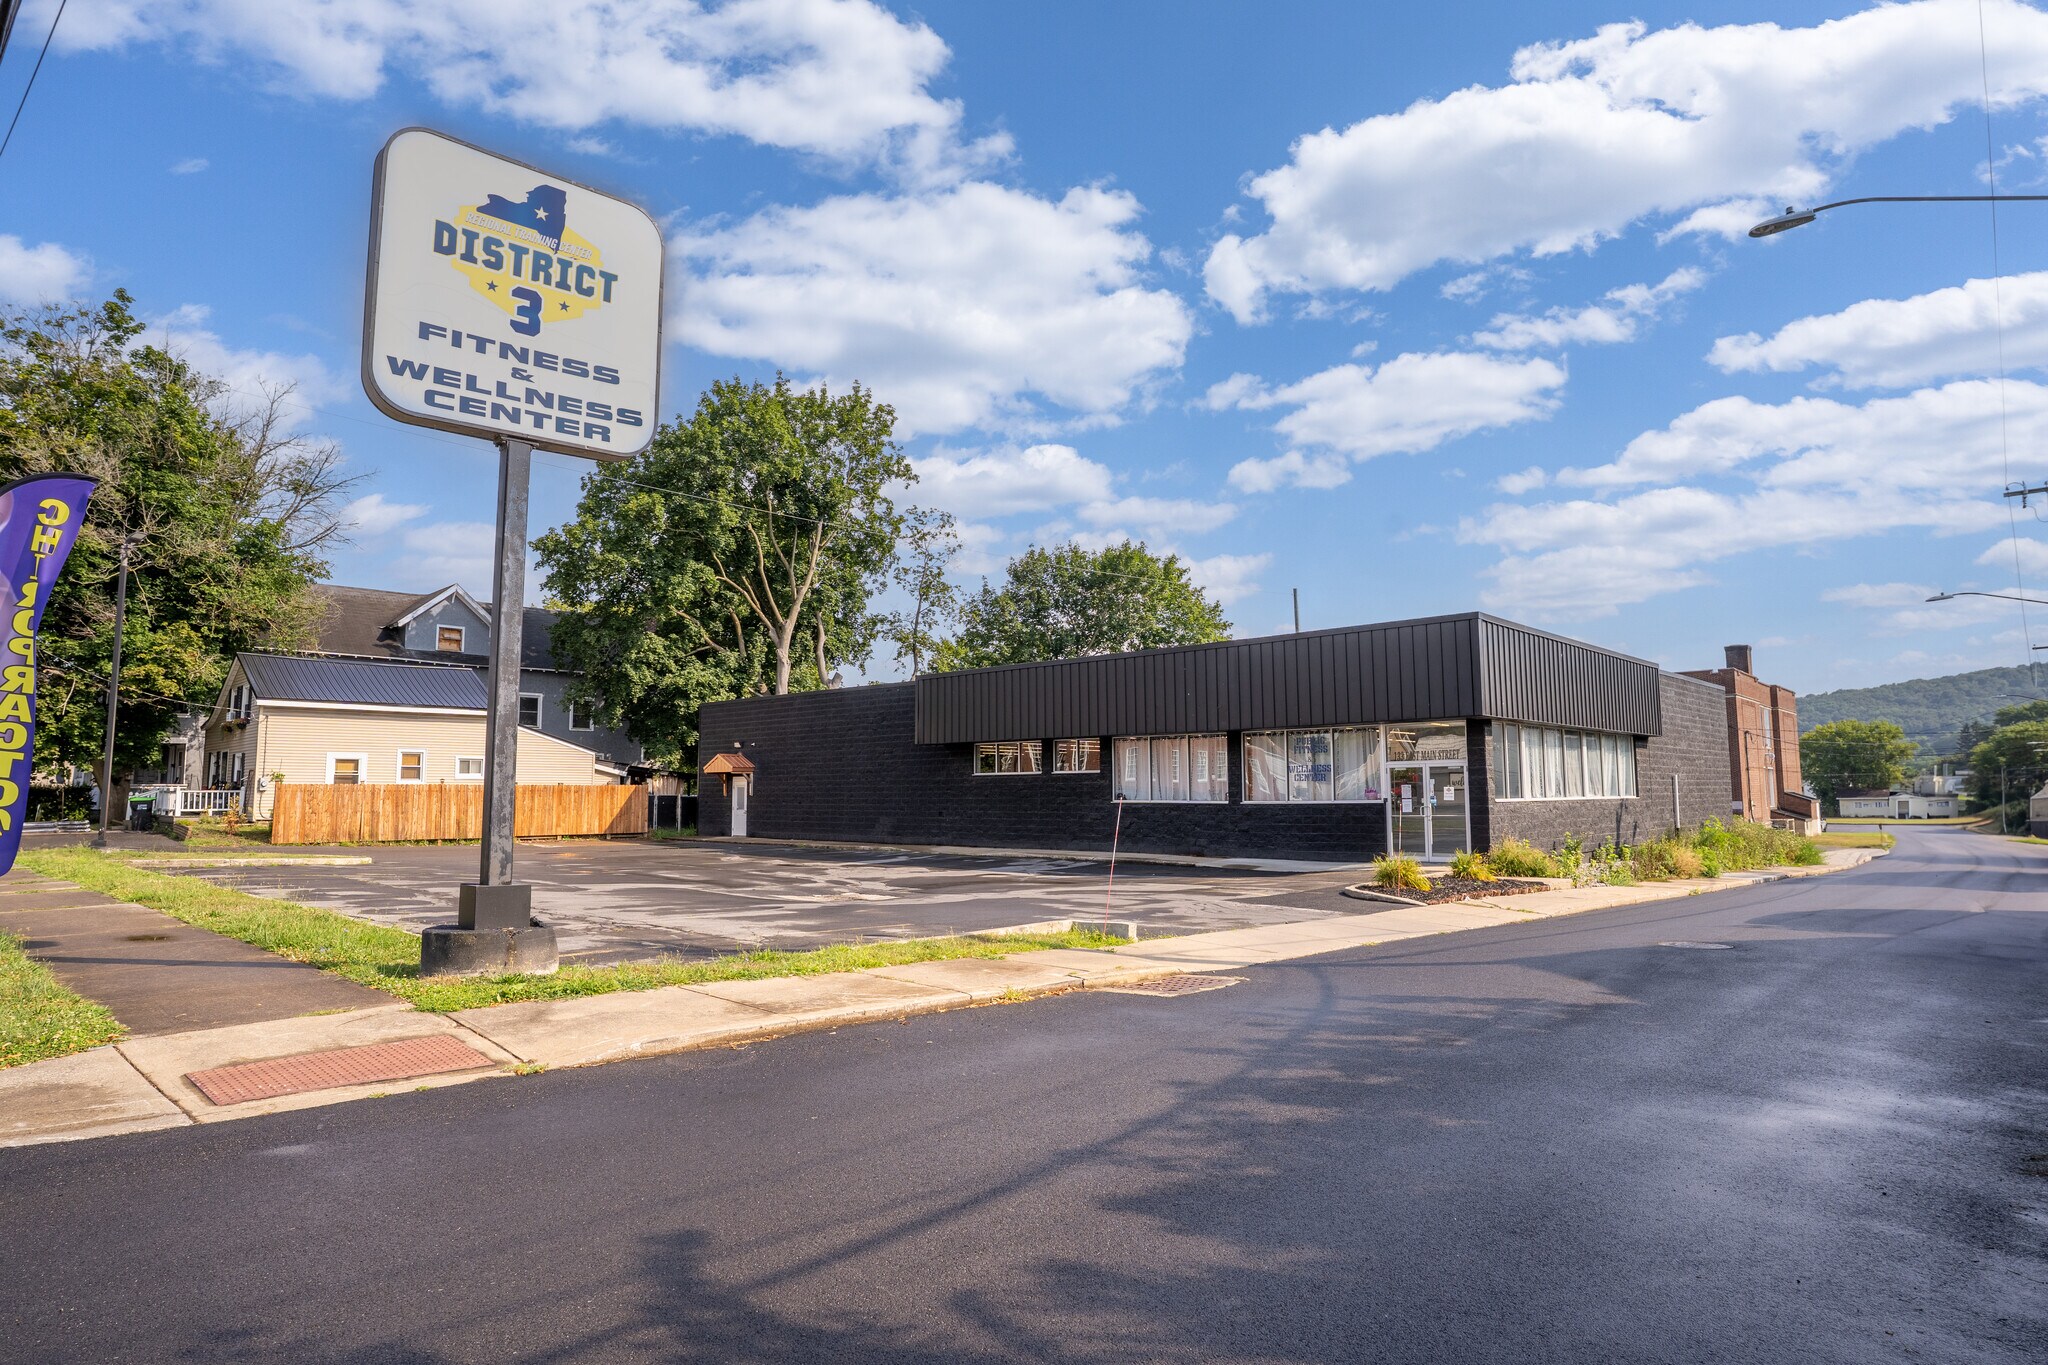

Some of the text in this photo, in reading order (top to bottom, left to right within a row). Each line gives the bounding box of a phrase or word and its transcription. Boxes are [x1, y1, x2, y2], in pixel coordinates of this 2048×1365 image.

[465, 211, 593, 260] REGIONAL TRAINING CENTER
[433, 219, 618, 303] DISTRICT
[509, 286, 543, 337] 3
[419, 321, 620, 385] FITNESS
[511, 367, 535, 383] &
[386, 355, 643, 427] WELLNESS
[424, 389, 611, 442] CENTER
[1288, 764, 1331, 773] WELLNESS
[1294, 745, 1328, 754] FITNESS
[1421, 750, 1437, 760] MAIN
[1438, 749, 1460, 760] STREET
[1294, 773, 1326, 781] CENTER
